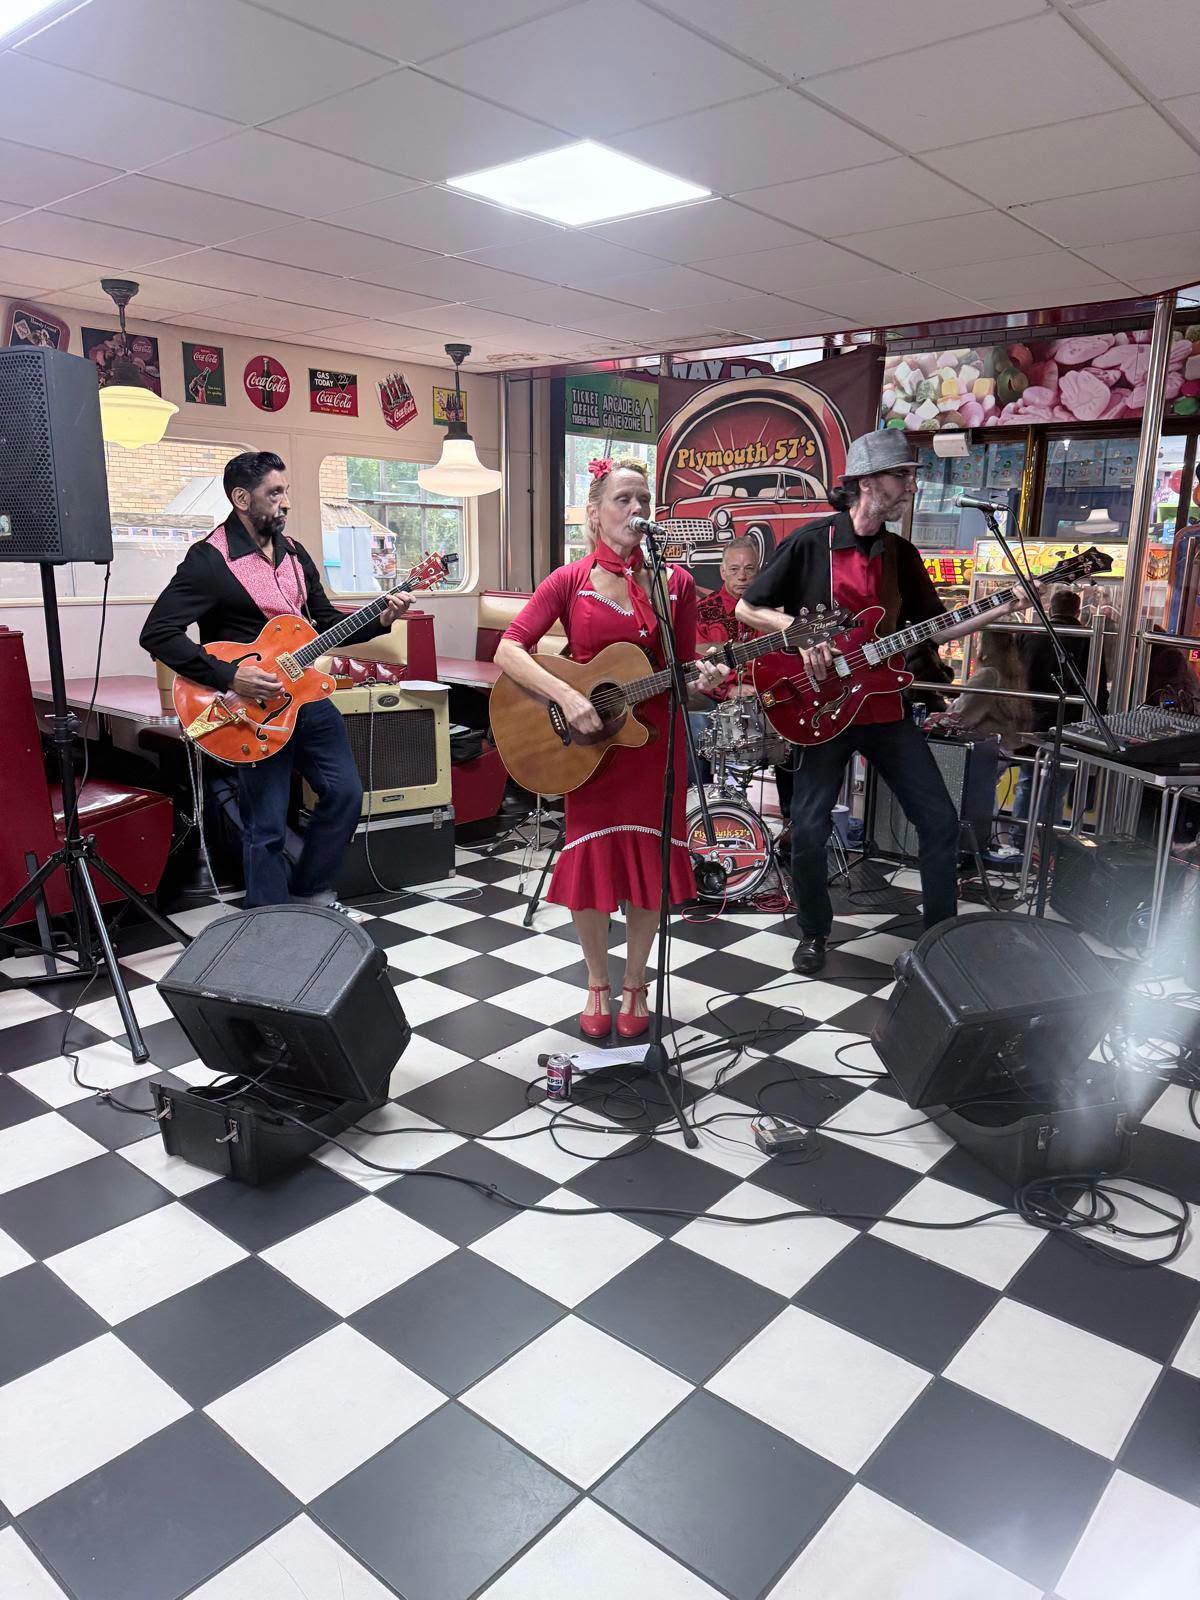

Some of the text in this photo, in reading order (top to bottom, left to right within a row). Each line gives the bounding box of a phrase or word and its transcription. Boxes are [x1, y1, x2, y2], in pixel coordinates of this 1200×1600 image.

[193, 351, 219, 364] Coca-Cola
[246, 371, 287, 394] Coca-Cola
[314, 378, 334, 387] TODAY
[316, 371, 330, 380] GAS
[316, 390, 353, 409] Coca-Cola
[571, 389, 599, 405] TICKET
[602, 395, 641, 416] ARCADE &
[393, 398, 415, 423] Coca-Cola
[572, 402, 599, 418] OFFICE
[571, 414, 600, 427] THEME PARK
[602, 413, 641, 431] GAME ZONE
[676, 436, 817, 471] Plymouth 57's
